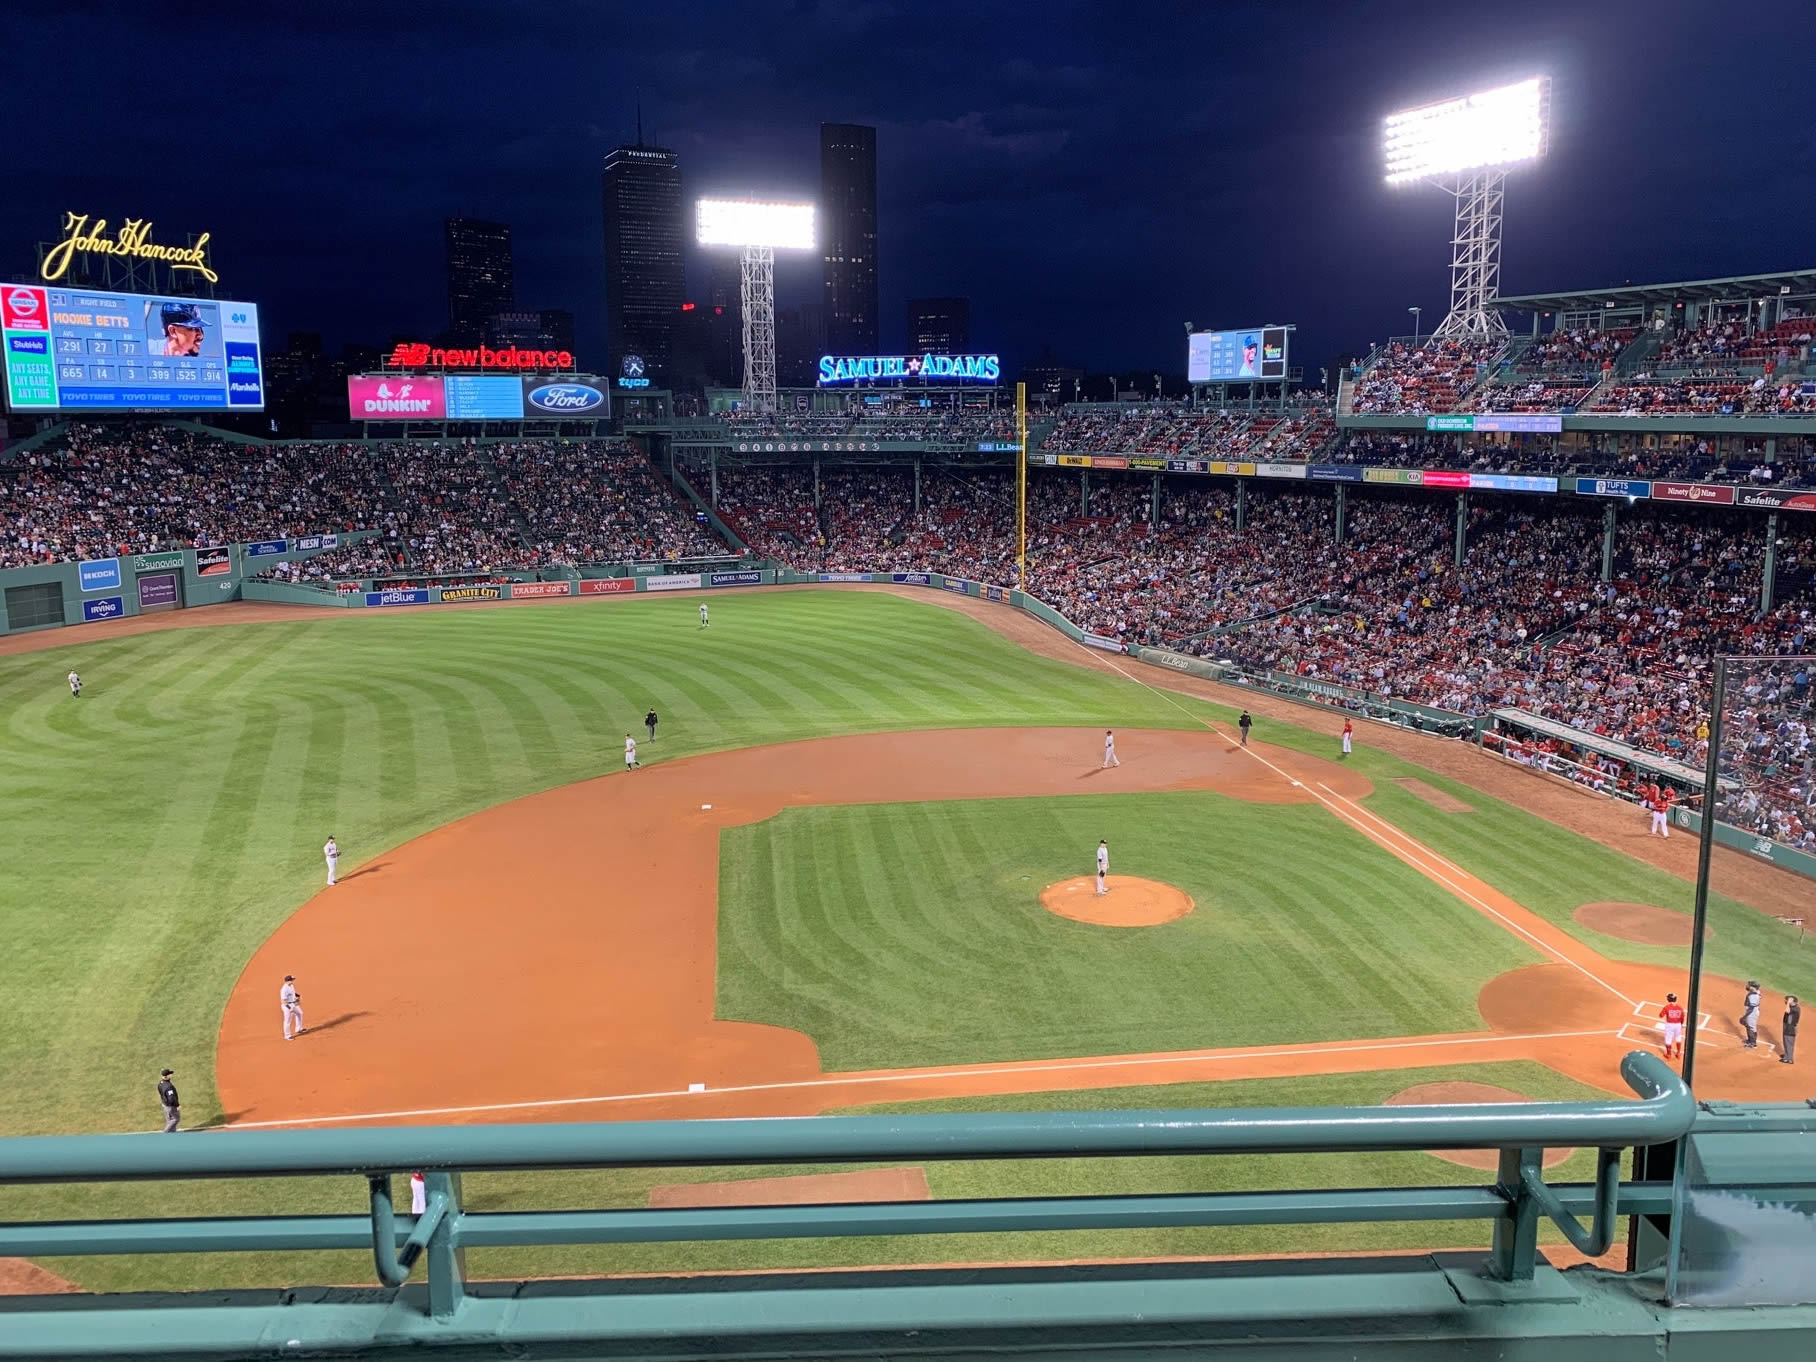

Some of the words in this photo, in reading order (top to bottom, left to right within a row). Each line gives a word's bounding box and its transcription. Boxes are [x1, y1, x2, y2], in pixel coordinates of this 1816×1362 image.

[41, 211, 116, 281] John
[112, 217, 219, 283] Hancock
[53, 312, 93, 325] MOOKIE
[95, 315, 129, 328] BETTS
[13, 340, 43, 349] StubHub
[60, 341, 80, 352] .291
[94, 342, 107, 353] 27
[123, 343, 135, 354] 77
[62, 367, 83, 378] 665
[97, 368, 108, 379] 14
[127, 369, 135, 379] 3
[819, 355, 910, 382] SAMUEL
[918, 352, 1000, 379] ADAMS
[230, 383, 260, 392] Marshalls
[618, 376, 650, 389] tyco
[544, 387, 588, 407] Ford
[364, 399, 431, 412] DUNKIN'
[1606, 481, 1629, 490] TUFTS
[1667, 487, 1689, 497] Ninety
[1701, 489, 1717, 498] Nine
[1743, 495, 1781, 506] Safelite
[299, 538, 320, 550] NESN
[145, 557, 183, 569] sunovion
[197, 555, 229, 566] Safelite
[92, 569, 115, 579] KOCH
[712, 574, 736, 583] SAMUEL
[737, 572, 760, 581] ADAMS
[219, 582, 231, 590] 420
[513, 586, 545, 596] TRADER
[546, 585, 569, 594] JOE'S
[593, 579, 622, 592] xfinity
[380, 592, 415, 605] jetBlue
[442, 588, 480, 600] GRANITE
[481, 588, 499, 598] CITY
[90, 603, 116, 615] IRVING
